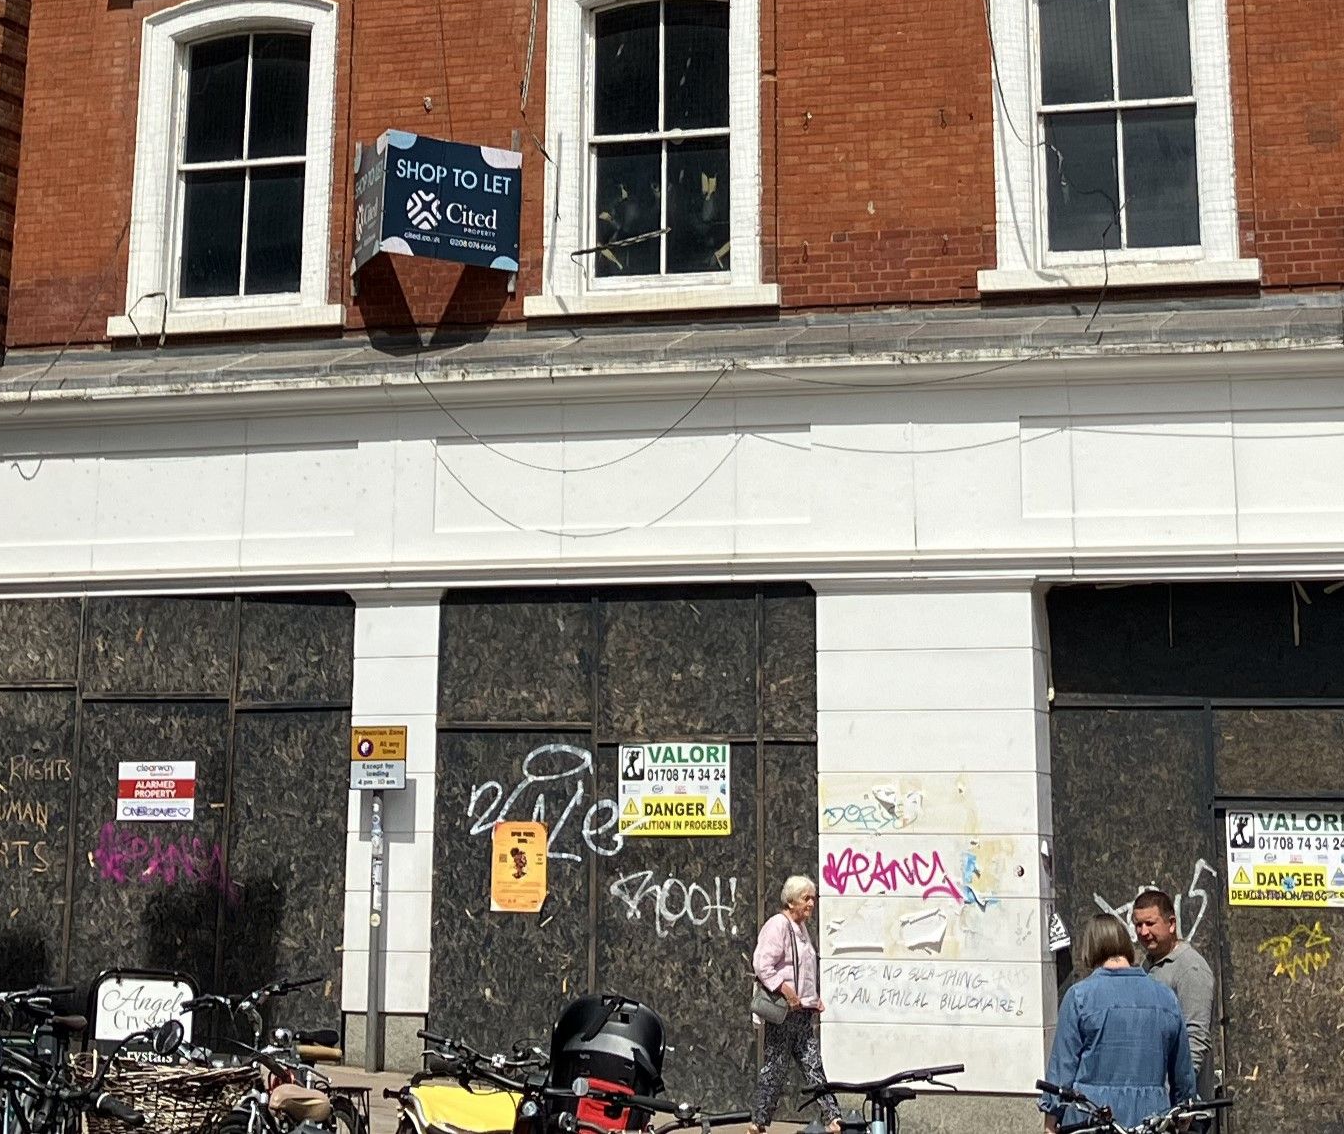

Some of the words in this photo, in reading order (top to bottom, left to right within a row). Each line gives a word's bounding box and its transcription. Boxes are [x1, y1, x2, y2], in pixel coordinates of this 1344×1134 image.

[396, 159, 447, 183] SHOP
[453, 169, 478, 189] TO
[484, 174, 511, 195] LET
[446, 203, 497, 229] Cited
[463, 227, 496, 237] PROPERTY
[647, 746, 726, 763] VALORI
[9, 754, 72, 785] RIGHTS
[647, 768, 679, 781] 01708
[682, 768, 695, 781] 74
[698, 768, 710, 781] 34
[713, 768, 726, 781] 24
[136, 780, 176, 789] ALARMED
[134, 789, 177, 798] PROPERTY
[644, 803, 705, 816] DANGER
[673, 821, 682, 830] IN
[684, 820, 728, 830] PROGRESS
[1258, 837, 1294, 850] 01708
[1297, 837, 1311, 850] 74
[1315, 837, 1329, 850] 34
[824, 964, 877, 984] THERE'S
[882, 966, 903, 981] NO
[908, 968, 934, 982] SUCH
[937, 969, 989, 989] THING
[102, 985, 184, 1023] Angel
[832, 988, 848, 1005] AS
[851, 987, 870, 1004] AN
[878, 988, 929, 1007] ETHICAL
